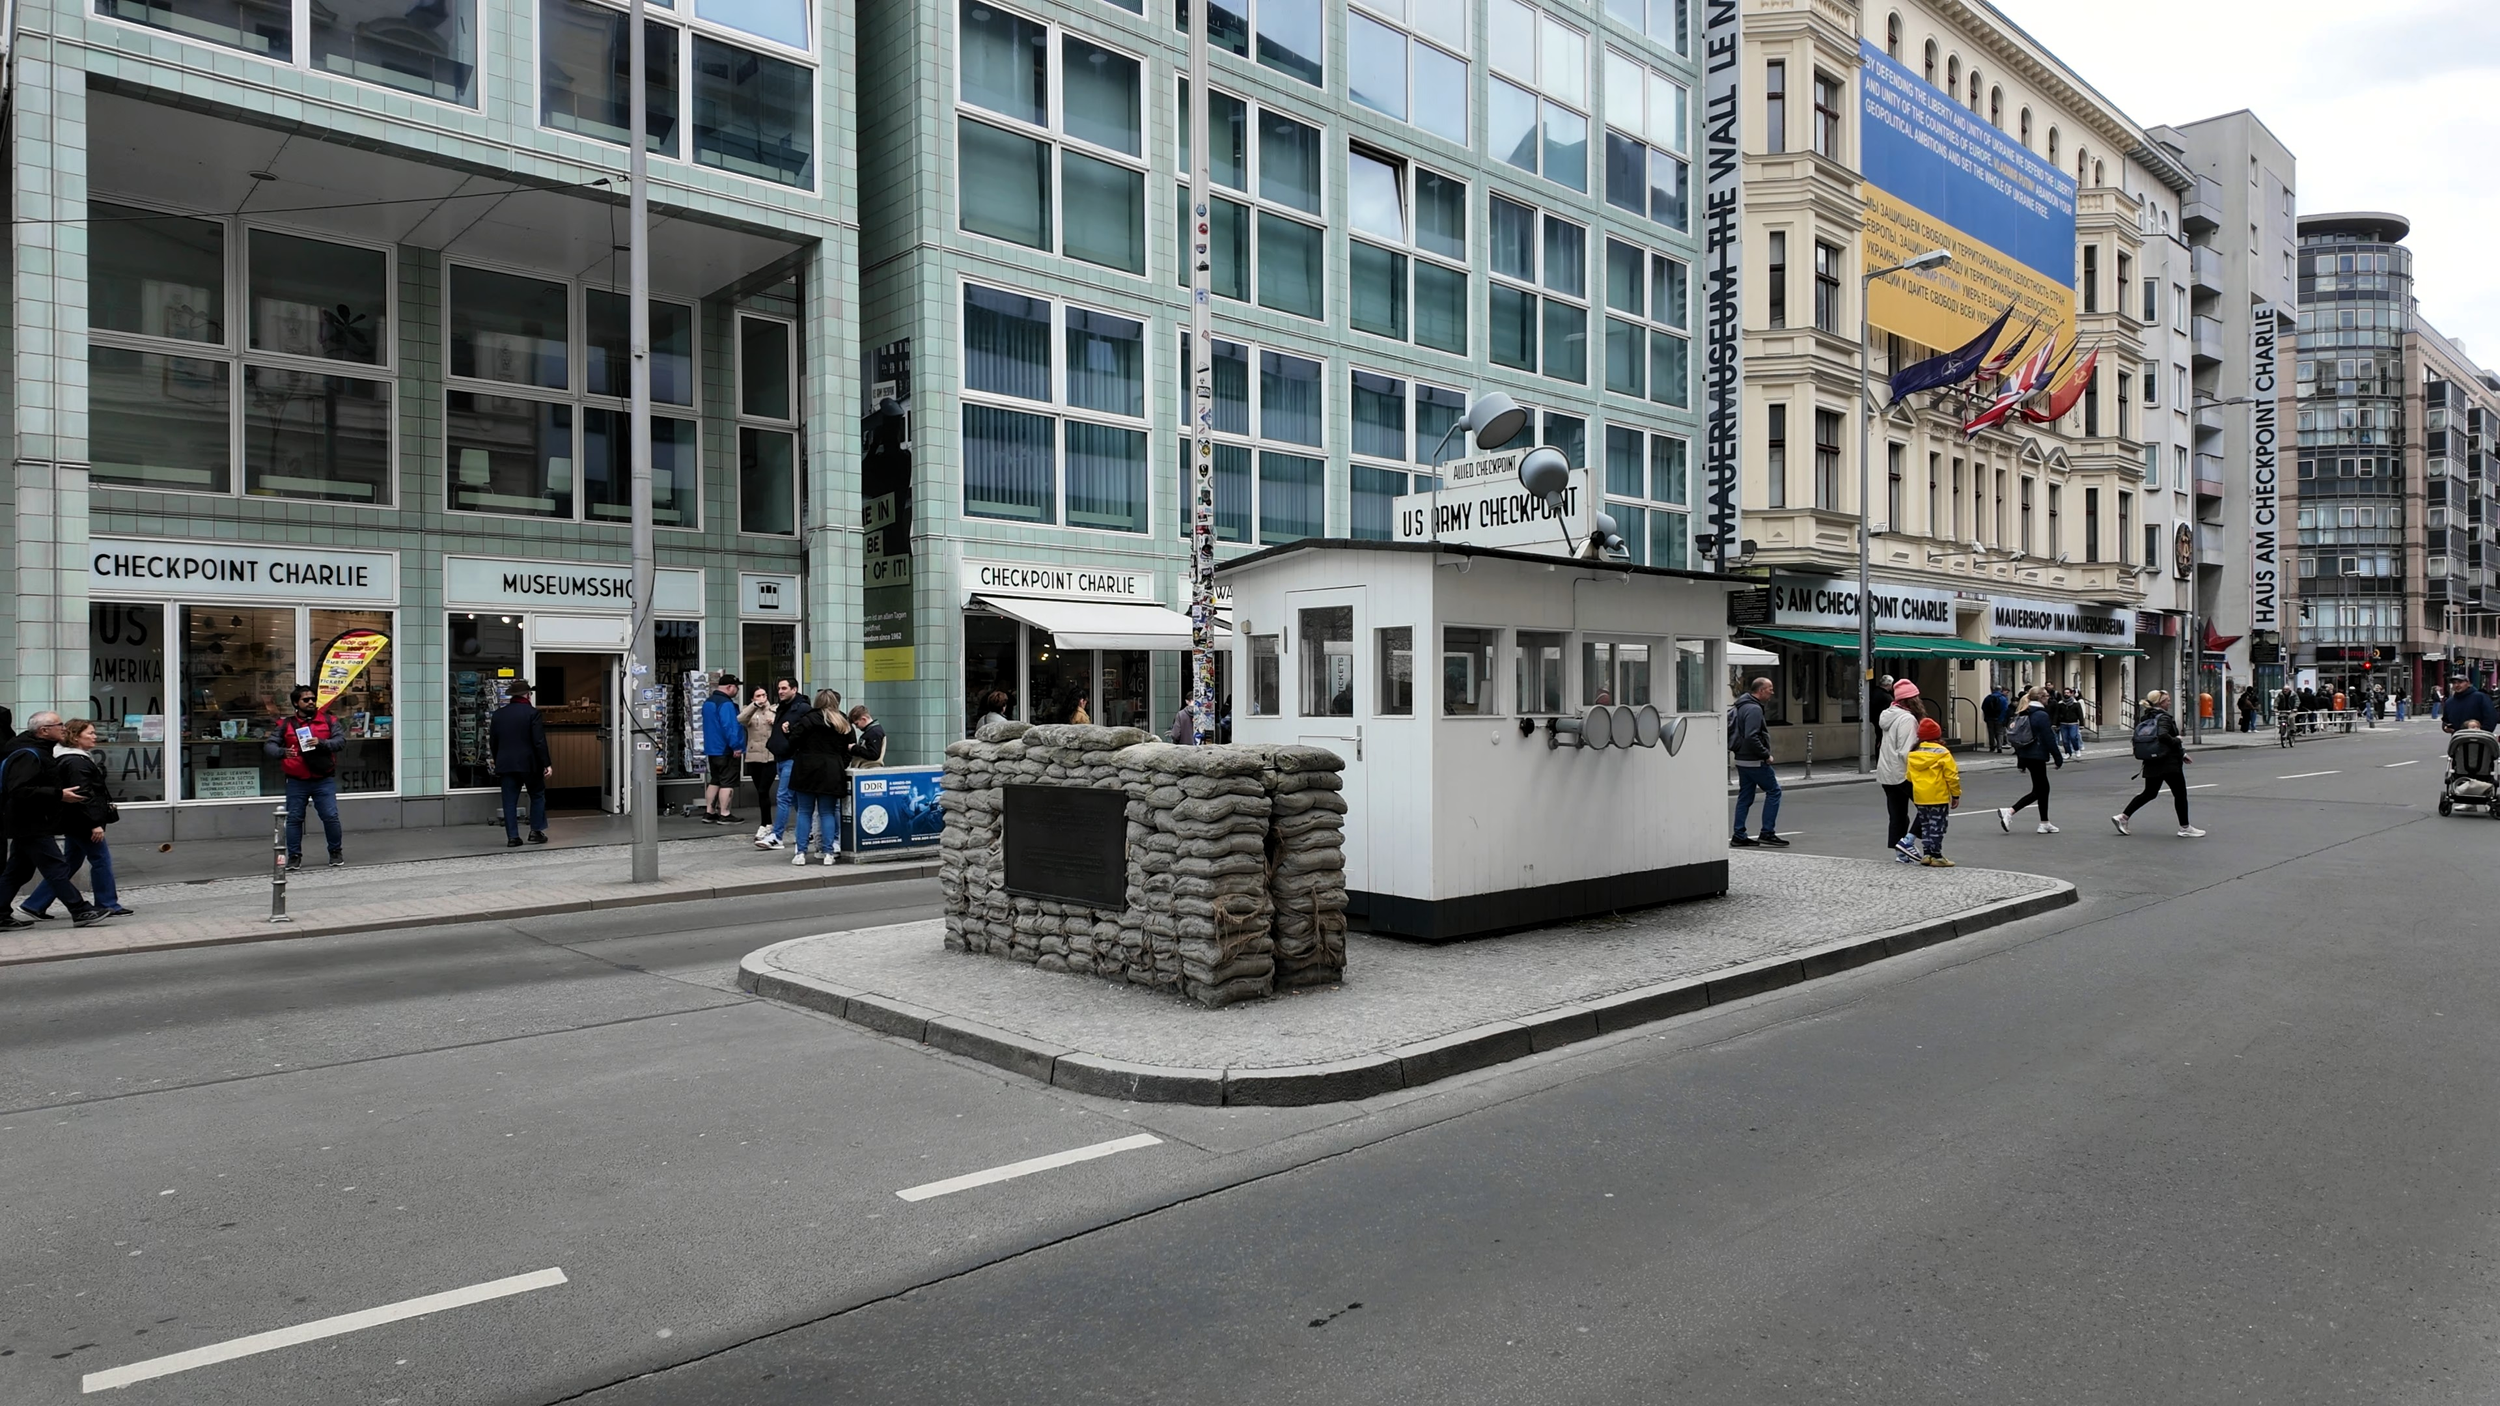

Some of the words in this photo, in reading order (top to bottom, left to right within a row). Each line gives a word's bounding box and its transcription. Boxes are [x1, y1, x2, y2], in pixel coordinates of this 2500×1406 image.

[1708, 32, 1736, 74] LE
[1708, 83, 1736, 184] WALL
[1865, 54, 1876, 72] BY
[1876, 62, 1914, 97] DEFENDING
[1914, 86, 1927, 106] THE
[1928, 95, 1953, 122] LIBERTY
[1953, 112, 1966, 131] AND
[1966, 120, 1983, 140] UNITY
[1983, 132, 1991, 146] OF
[1992, 137, 2015, 163] UKRAINE
[2015, 152, 2024, 168] WE
[2024, 159, 2044, 180] DEFEND
[2045, 171, 2054, 187] THE
[2055, 178, 2073, 199] LIBERTY
[1865, 77, 1880, 97] AND
[1881, 85, 1901, 110] UNITY
[1902, 100, 1911, 115] OF
[1912, 105, 1924, 125] THE
[1925, 114, 1960, 147] COUNTRIES
[1960, 137, 1968, 151] OF
[2035, 184, 2059, 208] ABANDON
[2059, 198, 2072, 216] YOUR
[1865, 98, 1914, 139] GEOPOLITICAL
[1914, 128, 1948, 159] AMBITIONS
[1948, 149, 1960, 167] AND
[1961, 156, 1973, 174] SET
[1973, 162, 1984, 181] THE
[1985, 171, 2004, 193] WHOLE
[2004, 183, 2013, 197] OF
[2013, 187, 2035, 211] UKRAINE
[1708, 187, 1736, 254] THE
[1866, 195, 1879, 214] МЫ
[1880, 203, 1920, 235] ЗАЩИЩАЕМ
[1921, 224, 1952, 250] СВОБОДУ
[1930, 289, 1959, 313] СВОБОДУ
[2255, 308, 2275, 392] CHARLIE
[1708, 265, 1737, 546] MAUERMUSEUM
[1453, 463, 1474, 481] ALLIED
[1476, 455, 1517, 477] CHECKPOINT
[2255, 399, 2275, 526] CHECKPOINT
[878, 499, 889, 521] IN
[867, 536, 880, 554] BE
[2255, 530, 2275, 564] AM
[94, 554, 258, 582] CHECKPOINT
[269, 562, 368, 586] CHARLIE
[873, 561, 888, 580] OF
[893, 558, 907, 578] IT!
[980, 566, 1073, 591] CHECKPOINT
[1078, 573, 1135, 594] CHARLIE
[1787, 587, 1812, 612] AM
[1815, 589, 1899, 619] CHECKOINT
[1901, 597, 1948, 623] CHARLIE
[2255, 571, 2275, 623] HAUS
[1995, 607, 2051, 631] MAUERSHOP
[2054, 613, 2065, 631] IM
[2067, 614, 2125, 636] MAUERMUSEUM
[864, 782, 883, 791] DDR
